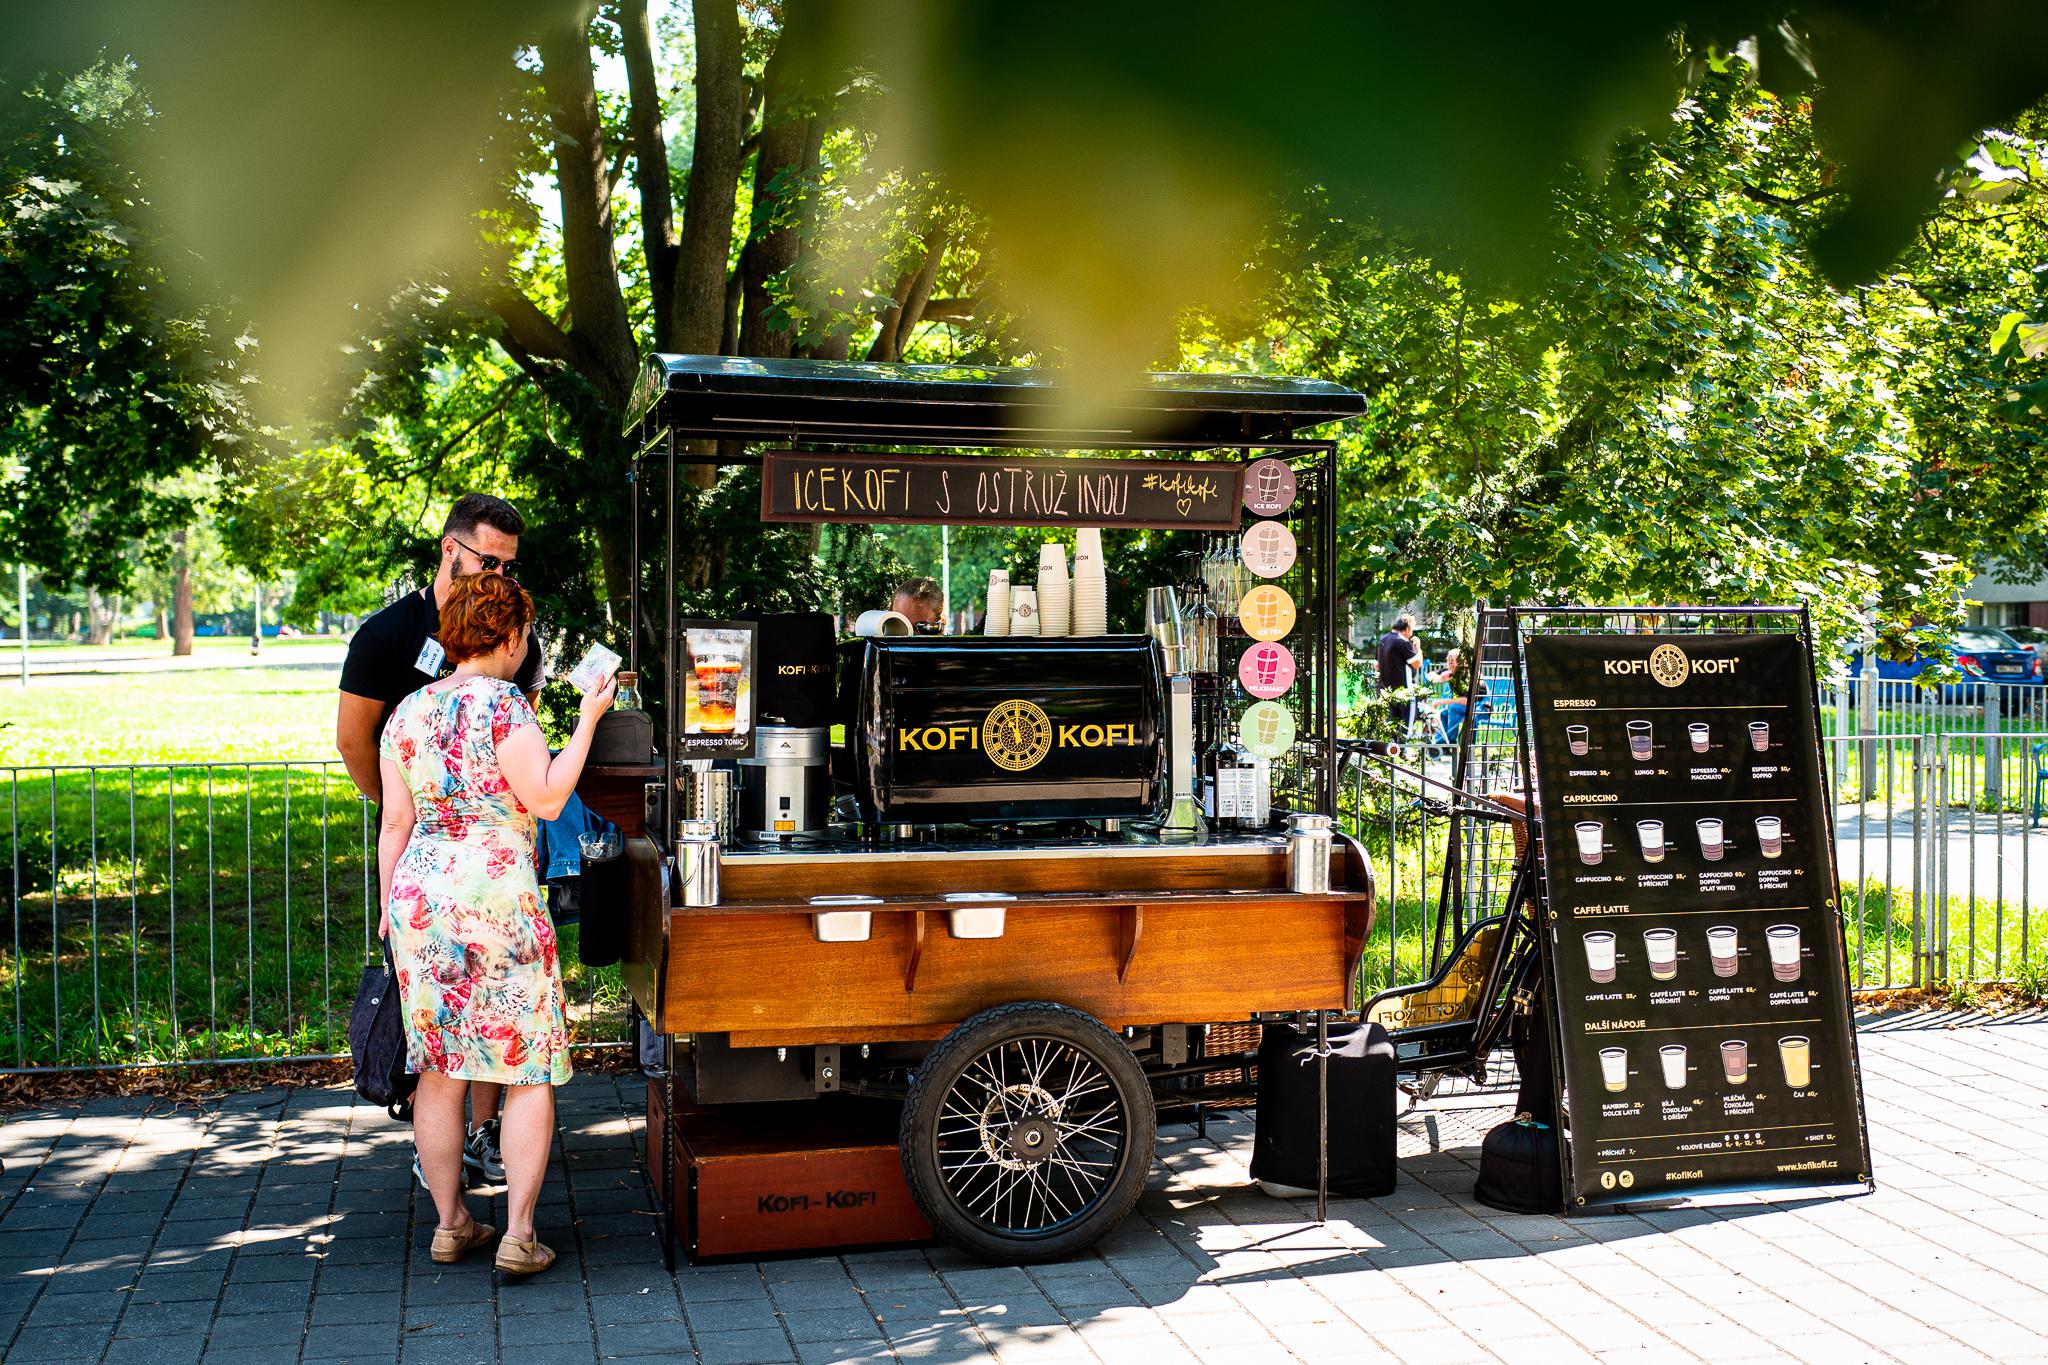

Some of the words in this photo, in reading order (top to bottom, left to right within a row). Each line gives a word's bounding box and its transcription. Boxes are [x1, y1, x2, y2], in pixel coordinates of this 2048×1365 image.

[794, 467, 911, 512] ICEKOFI
[936, 470, 950, 514] S
[1604, 660, 1648, 674] KOFI
[1554, 700, 1596, 708] ESPRESSO
[724, 738, 744, 746] TONIC
[899, 726, 978, 750] KOFI
[1058, 724, 1134, 748] KOFI
[1563, 794, 1618, 803] CAPPUCCINO
[1574, 905, 1601, 914] CAFFÉ
[1603, 905, 1629, 914] LATTE
[1585, 1020, 1609, 1031] DALŠÍ
[1612, 1020, 1646, 1029] NÁPOJE
[1777, 1160, 1838, 1172] www.kofikofi.cz
[1666, 1170, 1703, 1181] #KofiKofi
